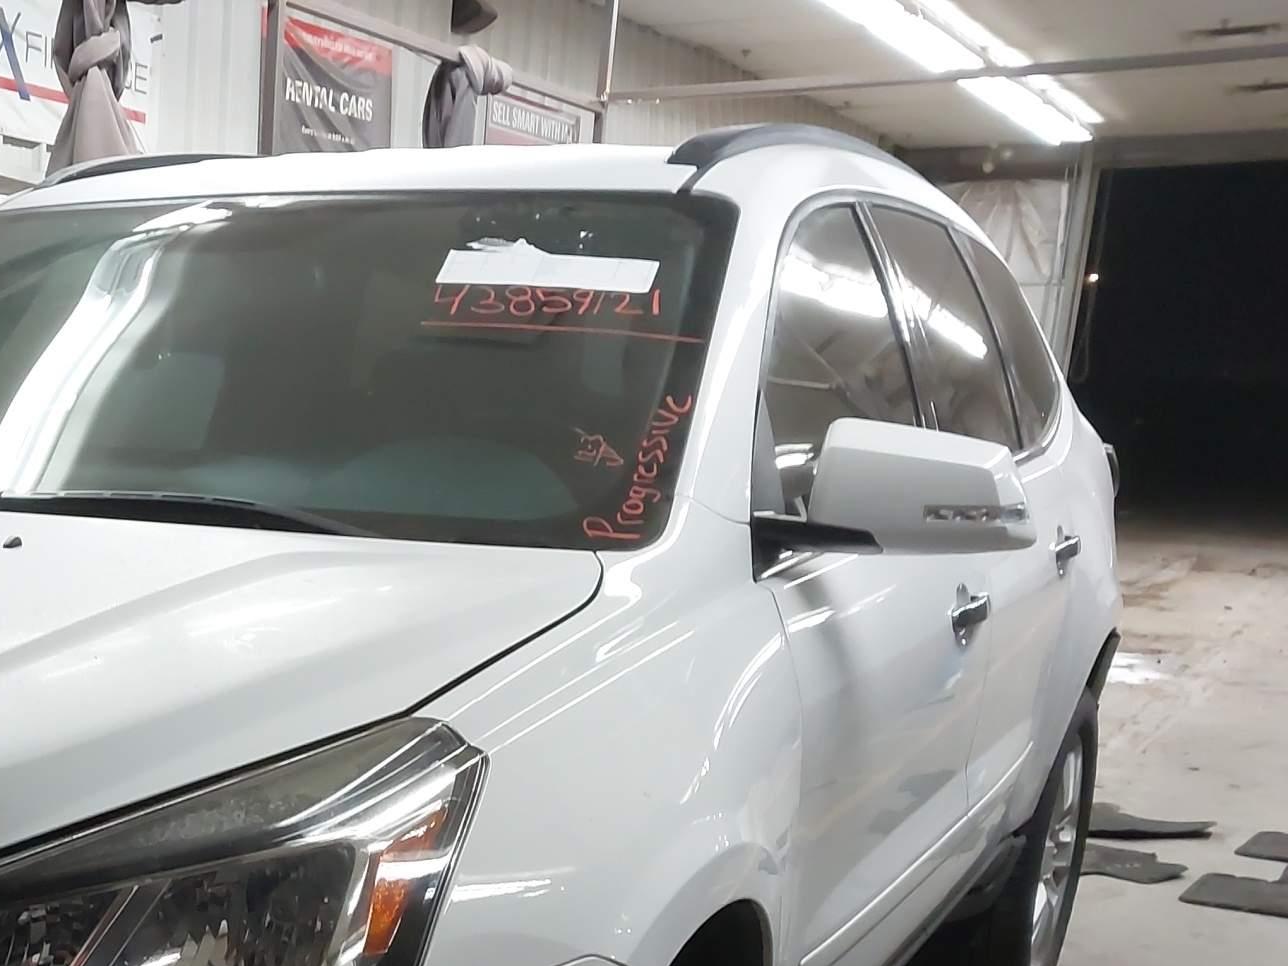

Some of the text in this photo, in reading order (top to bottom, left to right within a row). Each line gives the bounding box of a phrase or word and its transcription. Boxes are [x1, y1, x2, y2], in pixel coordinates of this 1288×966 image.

[285, 77, 373, 122] RENTAL CARS
[492, 101, 511, 127] SELL
[511, 107, 541, 136] SMART
[540, 115, 562, 141] WITH
[434, 284, 661, 316] 43859121
[582, 394, 692, 540] Progressive
